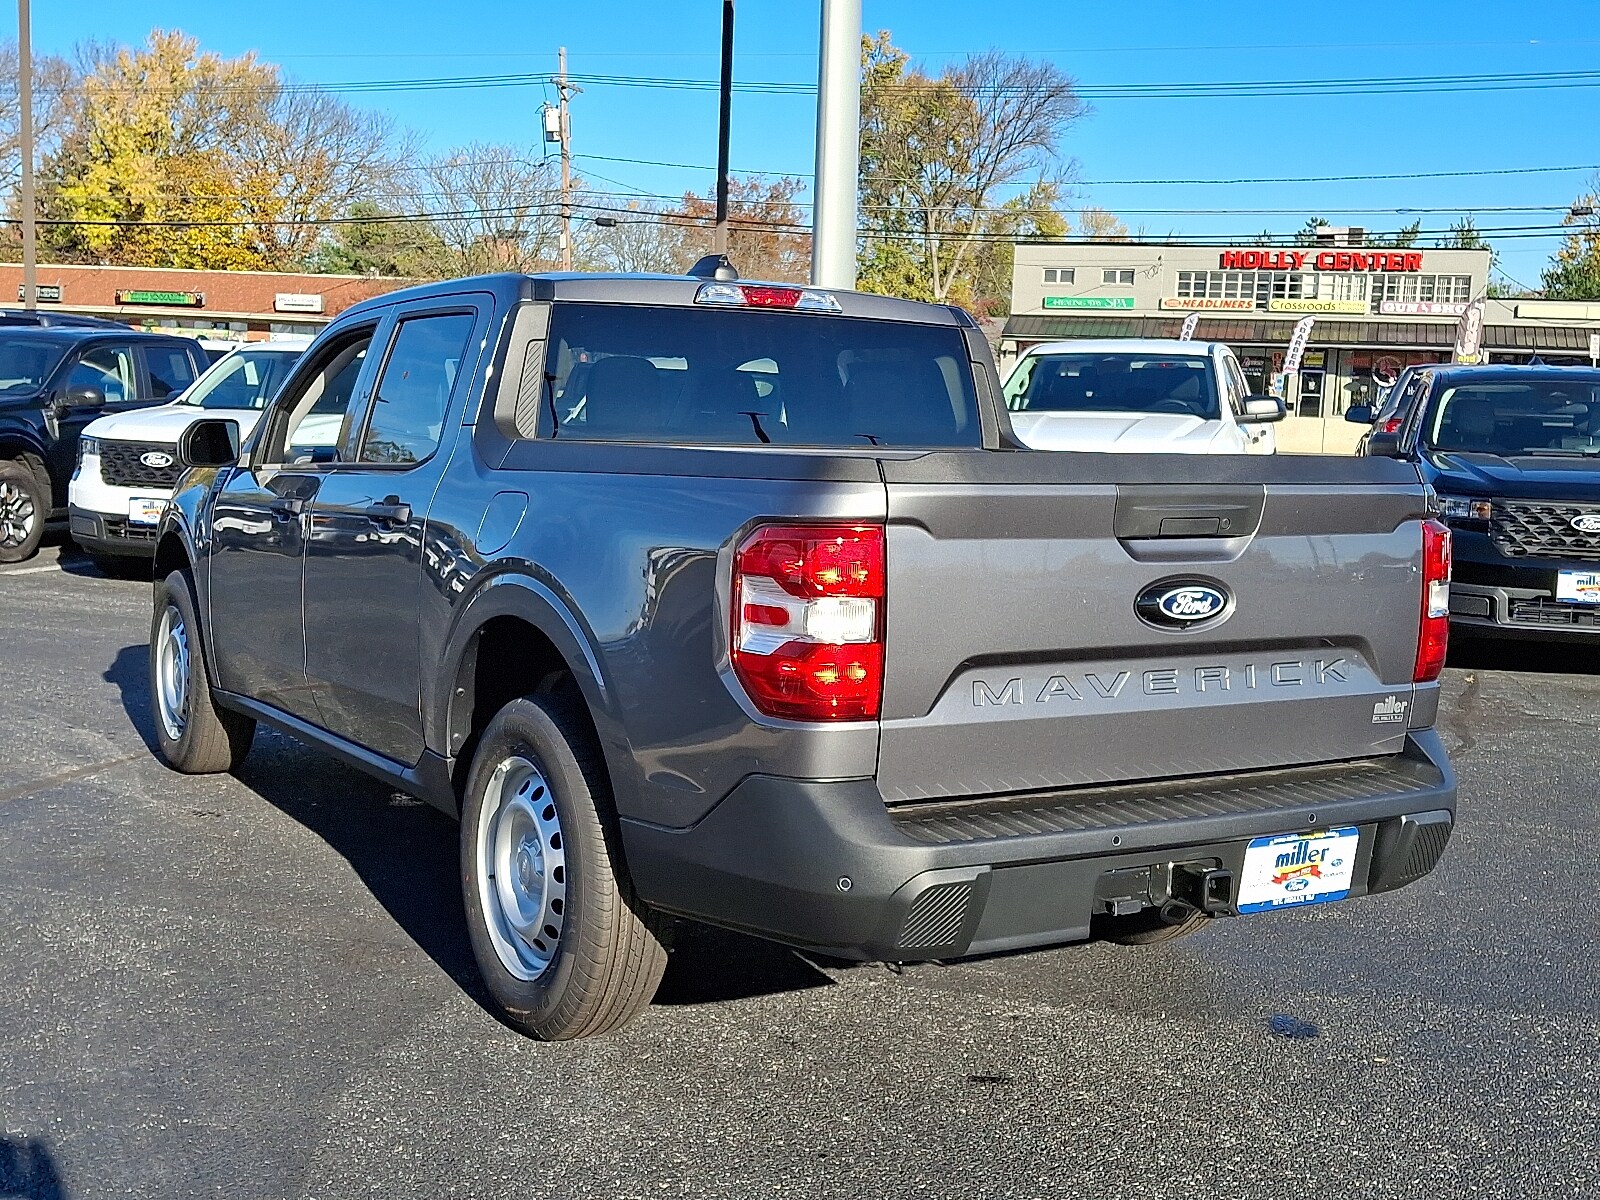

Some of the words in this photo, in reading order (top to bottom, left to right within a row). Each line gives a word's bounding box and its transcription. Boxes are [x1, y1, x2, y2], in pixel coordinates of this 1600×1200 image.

[1221, 250, 1309, 269] HOLLY
[1315, 251, 1423, 271] CENTER
[1105, 298, 1127, 308] SPA
[1181, 299, 1253, 309] HEADLINERS
[1270, 300, 1336, 311] Crossroads
[1383, 303, 1419, 313] GUN
[1430, 304, 1468, 314] SHO
[1458, 354, 1476, 363] and
[1172, 592, 1213, 614] Ford
[971, 658, 1349, 707] MAVERICK
[1373, 695, 1408, 714] miller
[1275, 841, 1330, 868] miller
